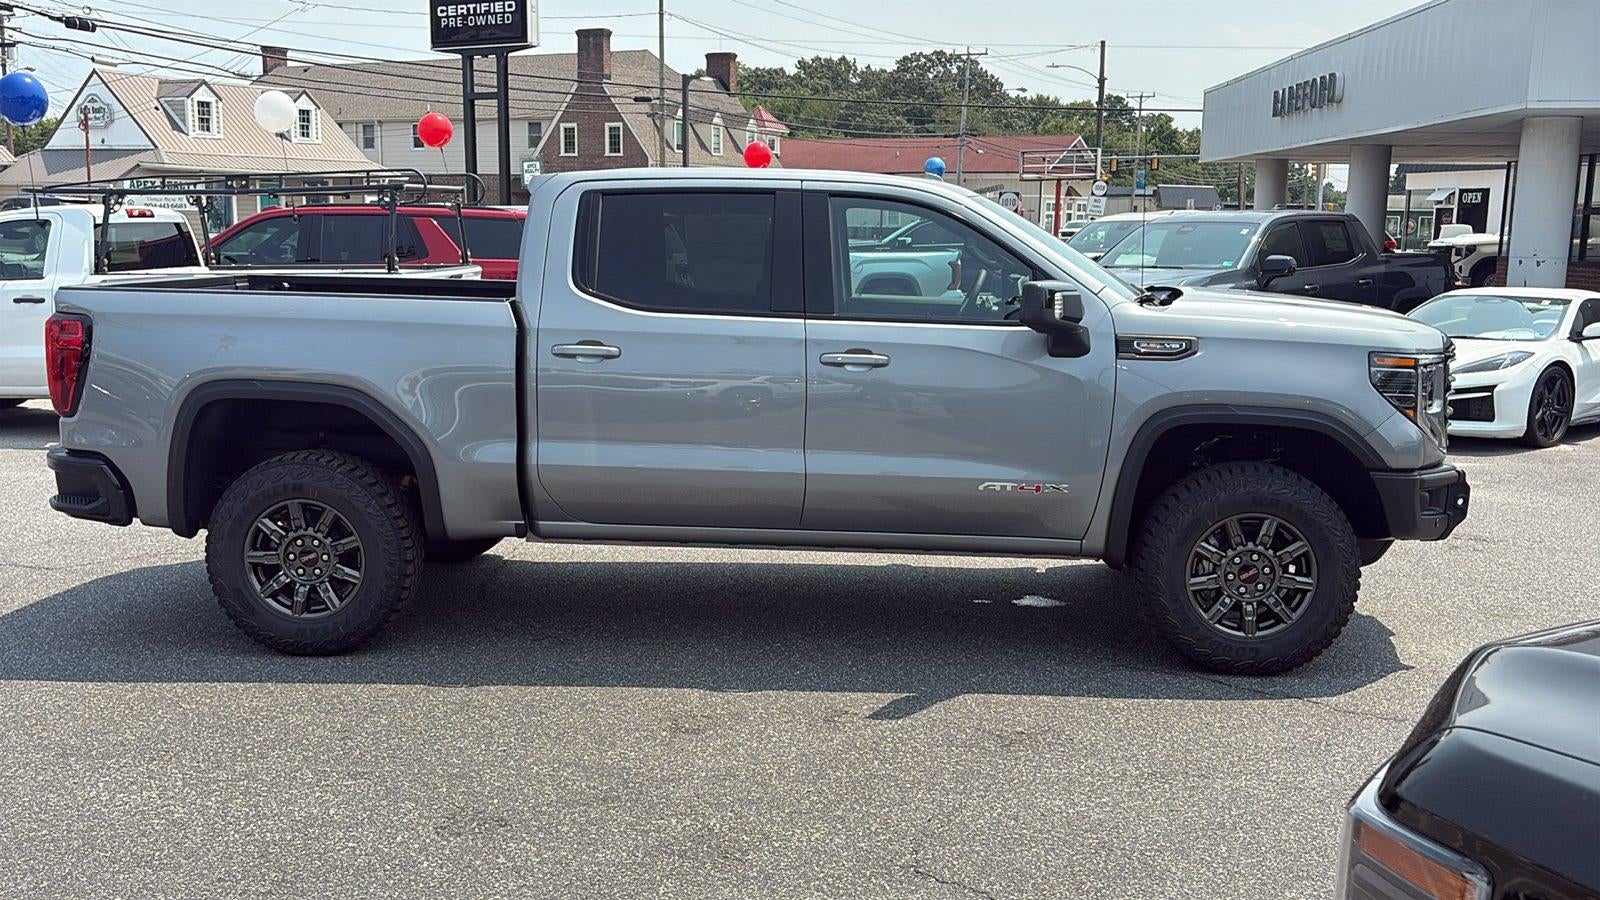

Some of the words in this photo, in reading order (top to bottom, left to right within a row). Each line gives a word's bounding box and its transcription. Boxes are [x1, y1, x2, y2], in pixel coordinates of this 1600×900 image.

[437, 1, 516, 17] CERTIFIED
[441, 13, 512, 28] PRE-OWNED
[1272, 72, 1345, 118] BAREFORD
[1001, 198, 1017, 207] 1010
[1462, 192, 1482, 204] OPEN
[978, 482, 1069, 495] AT4X
